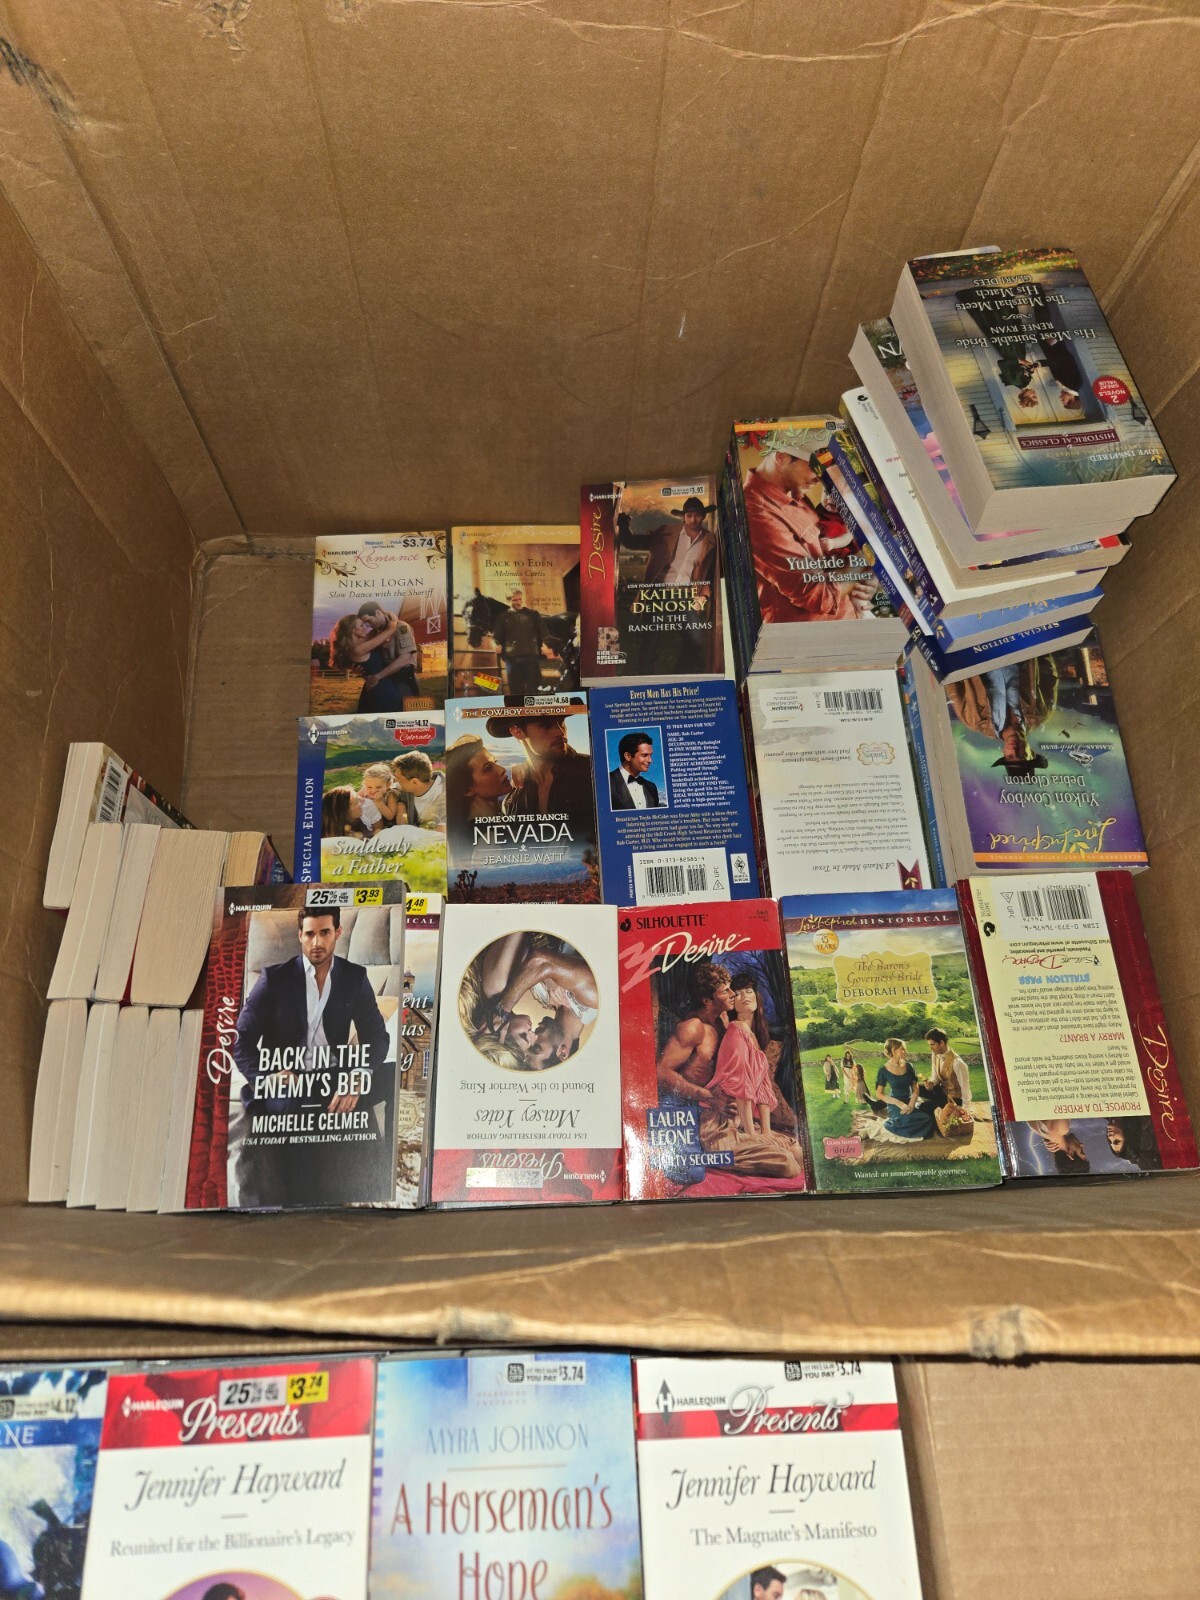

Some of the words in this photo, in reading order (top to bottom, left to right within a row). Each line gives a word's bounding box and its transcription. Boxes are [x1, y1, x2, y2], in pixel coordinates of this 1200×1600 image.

[976, 288, 1013, 298] Match
[1016, 285, 1038, 296] His
[956, 301, 992, 311] Meets
[995, 296, 1043, 309] Marshal
[1045, 295, 1068, 305] The
[990, 325, 1017, 334] RYAN
[1020, 322, 1053, 331] RENEE
[991, 334, 1036, 347] Suitable
[1040, 331, 1070, 342] Most
[1074, 329, 1096, 339] His
[956, 338, 988, 348] Bride
[1098, 389, 1125, 397] NOVELS
[1021, 438, 1059, 447] CLASSICS
[1061, 432, 1115, 444] HISTORICAL
[832, 453, 860, 488] Goodnight
[852, 486, 870, 508] Linda
[865, 509, 887, 536] Refuge
[403, 538, 433, 547] $3.74
[588, 505, 606, 579] Desire
[878, 533, 907, 571] Rancher's
[355, 549, 420, 569] Romance
[786, 557, 844, 570] Yuletide
[848, 555, 868, 567] Ba
[339, 580, 375, 588] NIKKI
[382, 578, 424, 586] LOGAN
[803, 574, 825, 583] Deb
[829, 572, 873, 582] Kastner
[394, 588, 406, 596] the
[409, 588, 434, 598] Sheriff
[641, 589, 698, 600] KATHIE
[629, 623, 683, 632] RANCHER'S
[685, 622, 712, 630] ARMS
[1017, 622, 1060, 638] SPECIAL
[973, 635, 1015, 653] EDITION
[630, 690, 646, 699] Every
[647, 689, 660, 698] Man
[660, 689, 671, 697] Has
[672, 688, 682, 697] His
[683, 686, 699, 696] Price!
[1005, 773, 1049, 788] Clopton
[1052, 774, 1085, 787] Debra
[303, 777, 315, 830] EDITION
[1000, 790, 1052, 806] Cowboy
[1054, 791, 1099, 807] Yukon
[475, 815, 501, 824] HOME
[502, 815, 515, 823] ON
[517, 814, 534, 822] THE
[536, 813, 569, 822] RANCH:
[473, 822, 573, 845] NEVADA
[331, 837, 412, 856] Suddenly
[301, 833, 313, 883] SPECIAL
[481, 852, 531, 864] JEANNIE
[533, 852, 564, 862] WATT
[332, 863, 344, 876] a
[346, 857, 404, 875] Father
[863, 863, 884, 871] Match
[885, 862, 895, 871] A
[235, 904, 272, 912] HARLEQUIN
[636, 914, 706, 930] SILHOUETTE
[795, 917, 819, 935] Love
[817, 916, 857, 929] Inspired
[861, 916, 949, 925] HISTORICAL
[660, 931, 750, 974] Desire
[1002, 954, 1066, 969] Desire
[842, 971, 893, 988] Governess
[893, 970, 923, 981] Bride
[843, 988, 897, 998] DEBORAH
[902, 986, 930, 995] HALE
[206, 995, 242, 1085] Desire
[1060, 1034, 1089, 1043] BRANT?
[1090, 1033, 1096, 1041] A
[1098, 1032, 1125, 1040] MARRY
[258, 1046, 306, 1072] BACK
[313, 1045, 330, 1070] IN
[337, 1044, 370, 1068] THE
[1136, 1014, 1177, 1141] Desire
[253, 1075, 330, 1100] ENEMY'S
[337, 1071, 371, 1096] BED
[460, 1081, 486, 1093] King
[489, 1083, 528, 1093] Warrior
[531, 1083, 547, 1093] the
[549, 1083, 560, 1092] to
[562, 1082, 595, 1093] Bound
[1054, 1104, 1082, 1113] RYDER?
[1084, 1104, 1090, 1112] A
[1093, 1103, 1102, 1111] TO
[1105, 1102, 1141, 1111] PROPOSE
[474, 1109, 514, 1128] Yates
[520, 1103, 581, 1128] Maisey
[649, 1111, 695, 1127] LAURA
[252, 1113, 314, 1133] MICHELLE
[319, 1112, 368, 1130] CELMER
[242, 1137, 258, 1146] USA
[260, 1136, 288, 1145] TODAY
[289, 1134, 341, 1144] BESTSELLING
[343, 1132, 377, 1142] AUTHOR
[651, 1129, 694, 1145] LEONE
[689, 1153, 731, 1165] SECRETS
[559, 1365, 584, 1381] $3.74
[133, 1399, 184, 1410] HARLEQUIN
[676, 1397, 725, 1406] HARLEQUIN
[724, 1385, 854, 1434] Presents
[179, 1396, 301, 1441] Presents
[426, 1427, 480, 1454] MYRA
[488, 1424, 589, 1453] JOHNSON
[125, 1465, 225, 1510] Jennifer
[231, 1458, 347, 1503] Hayward
[666, 1463, 760, 1509] Jennifer
[769, 1461, 876, 1503] Hayward
[391, 1482, 412, 1535] A
[426, 1473, 613, 1535] Horseman's
[691, 1529, 722, 1546] The
[726, 1525, 801, 1547] Magnate's
[804, 1521, 877, 1541] Manifesto
[110, 1538, 172, 1556] Reunited
[176, 1538, 196, 1553] for
[199, 1536, 221, 1551] the
[224, 1530, 302, 1550] Billionaire's
[305, 1528, 356, 1547] Legacy
